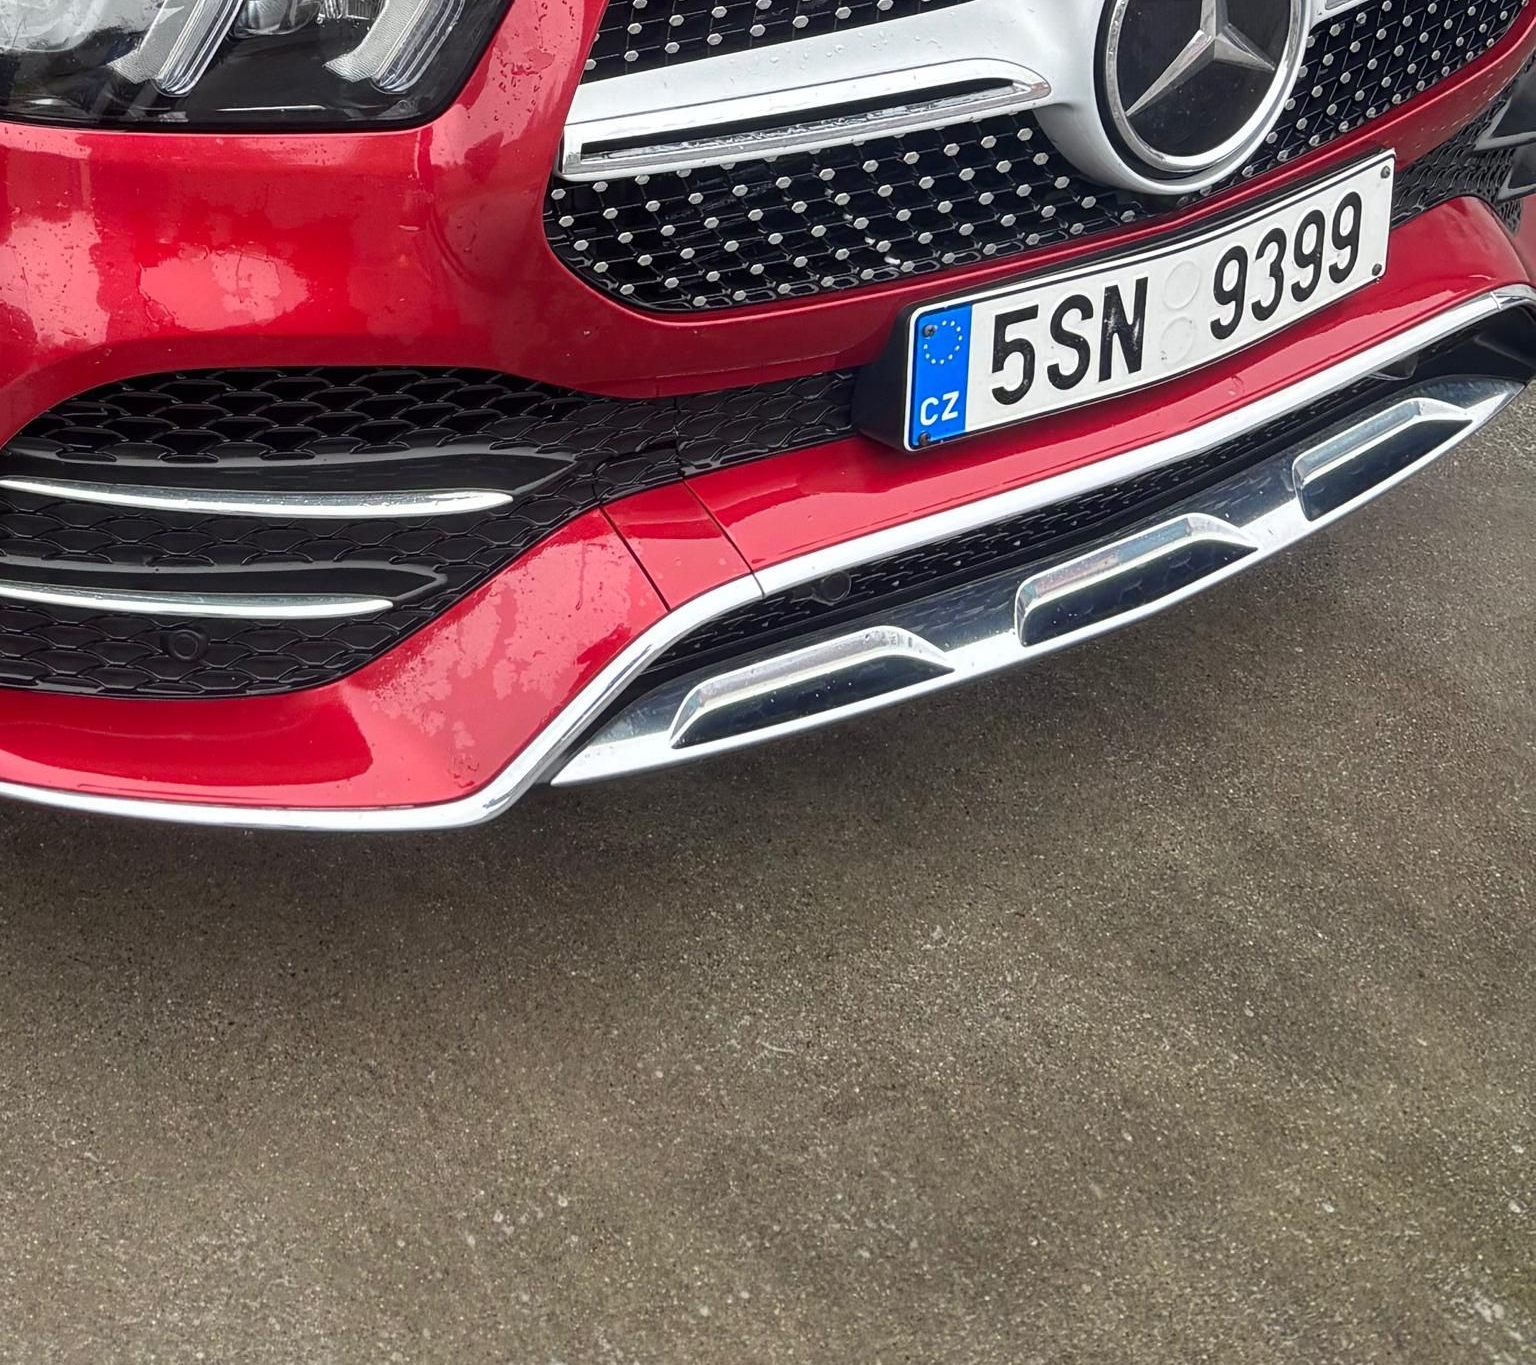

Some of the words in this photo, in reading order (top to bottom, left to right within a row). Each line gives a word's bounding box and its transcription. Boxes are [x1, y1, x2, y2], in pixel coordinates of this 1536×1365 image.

[1210, 190, 1363, 341] 9399
[991, 275, 1149, 407] 5SN
[919, 390, 959, 427] CZ
